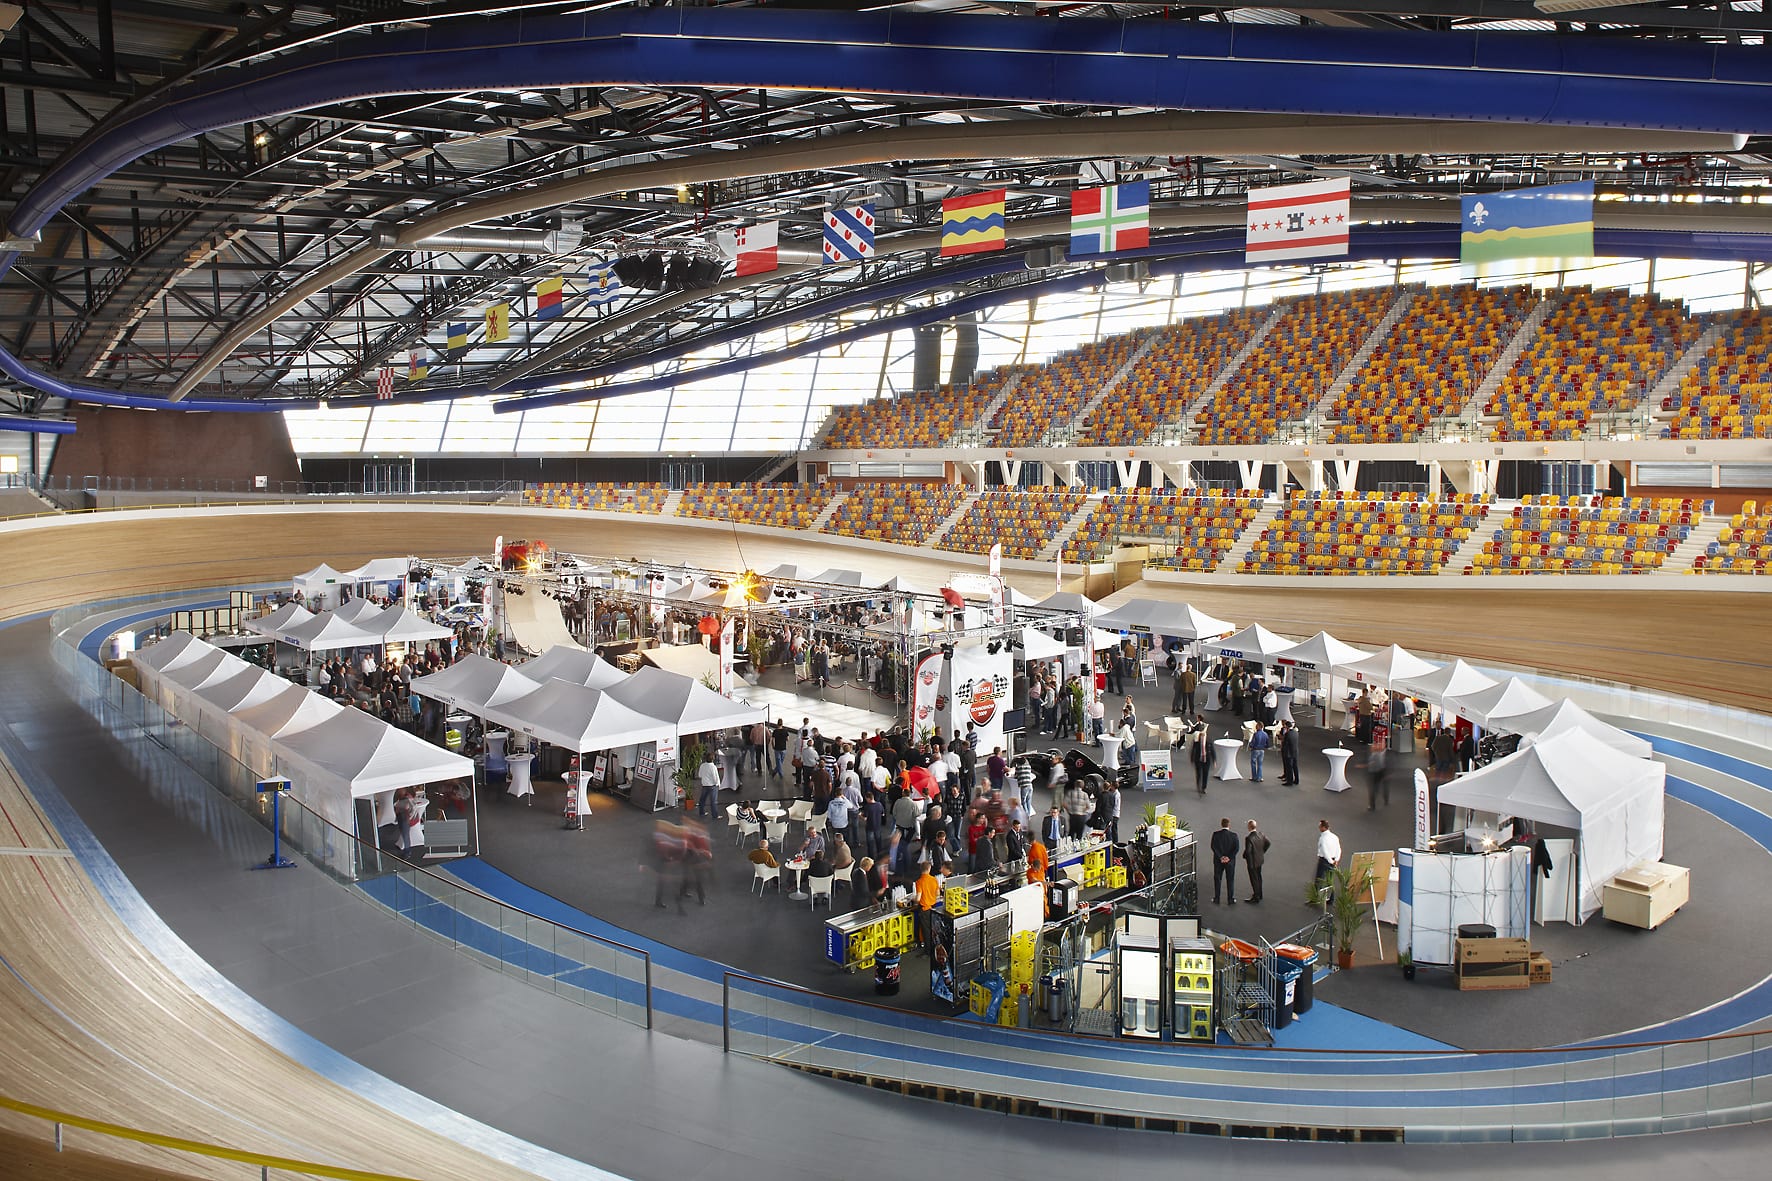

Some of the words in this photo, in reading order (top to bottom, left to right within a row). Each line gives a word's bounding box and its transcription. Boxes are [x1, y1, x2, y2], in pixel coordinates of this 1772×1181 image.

[1220, 649, 1243, 658] ATAG
[960, 698, 978, 706] FULL
[980, 691, 1006, 702] SPEED
